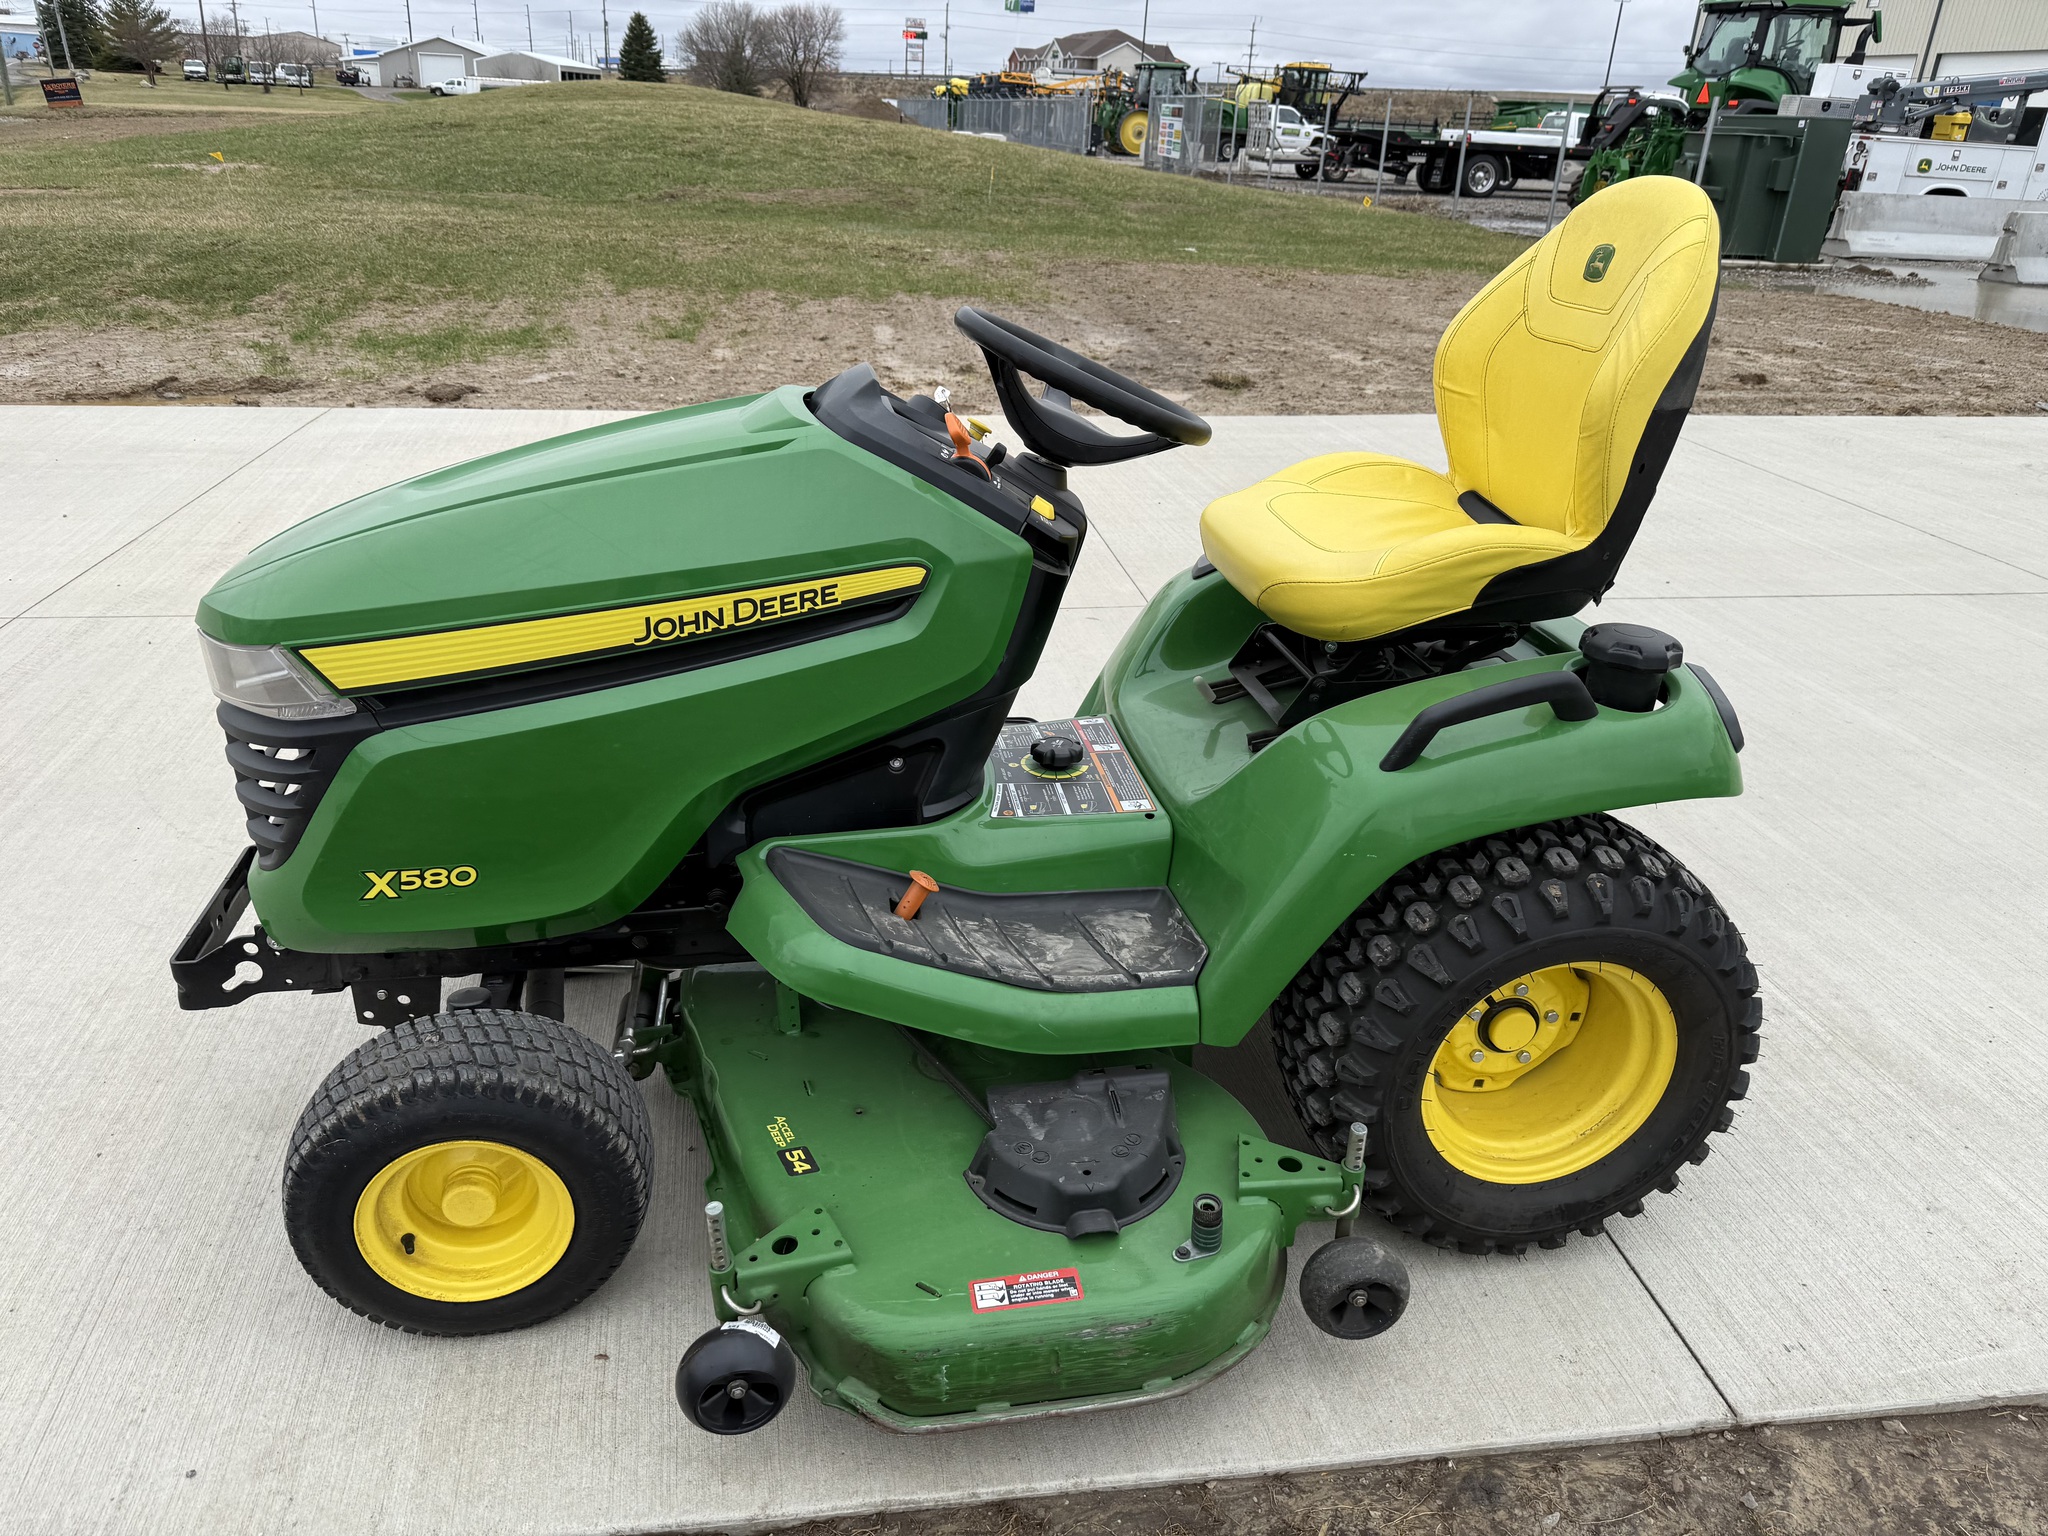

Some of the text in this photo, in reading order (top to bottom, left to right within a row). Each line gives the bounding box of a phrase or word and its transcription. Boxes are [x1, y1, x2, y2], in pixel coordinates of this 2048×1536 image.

[1935, 163, 1987, 174] JOHN DEERE
[634, 583, 839, 644] JOHN DEERE
[361, 865, 478, 900] X580
[767, 1123, 787, 1148] DEEP
[774, 1116, 795, 1143] ACCEL
[785, 1149, 812, 1174] 54
[1013, 1278, 1064, 1290] ROTATING BLADE
[1027, 1271, 1059, 1281] DANGER
